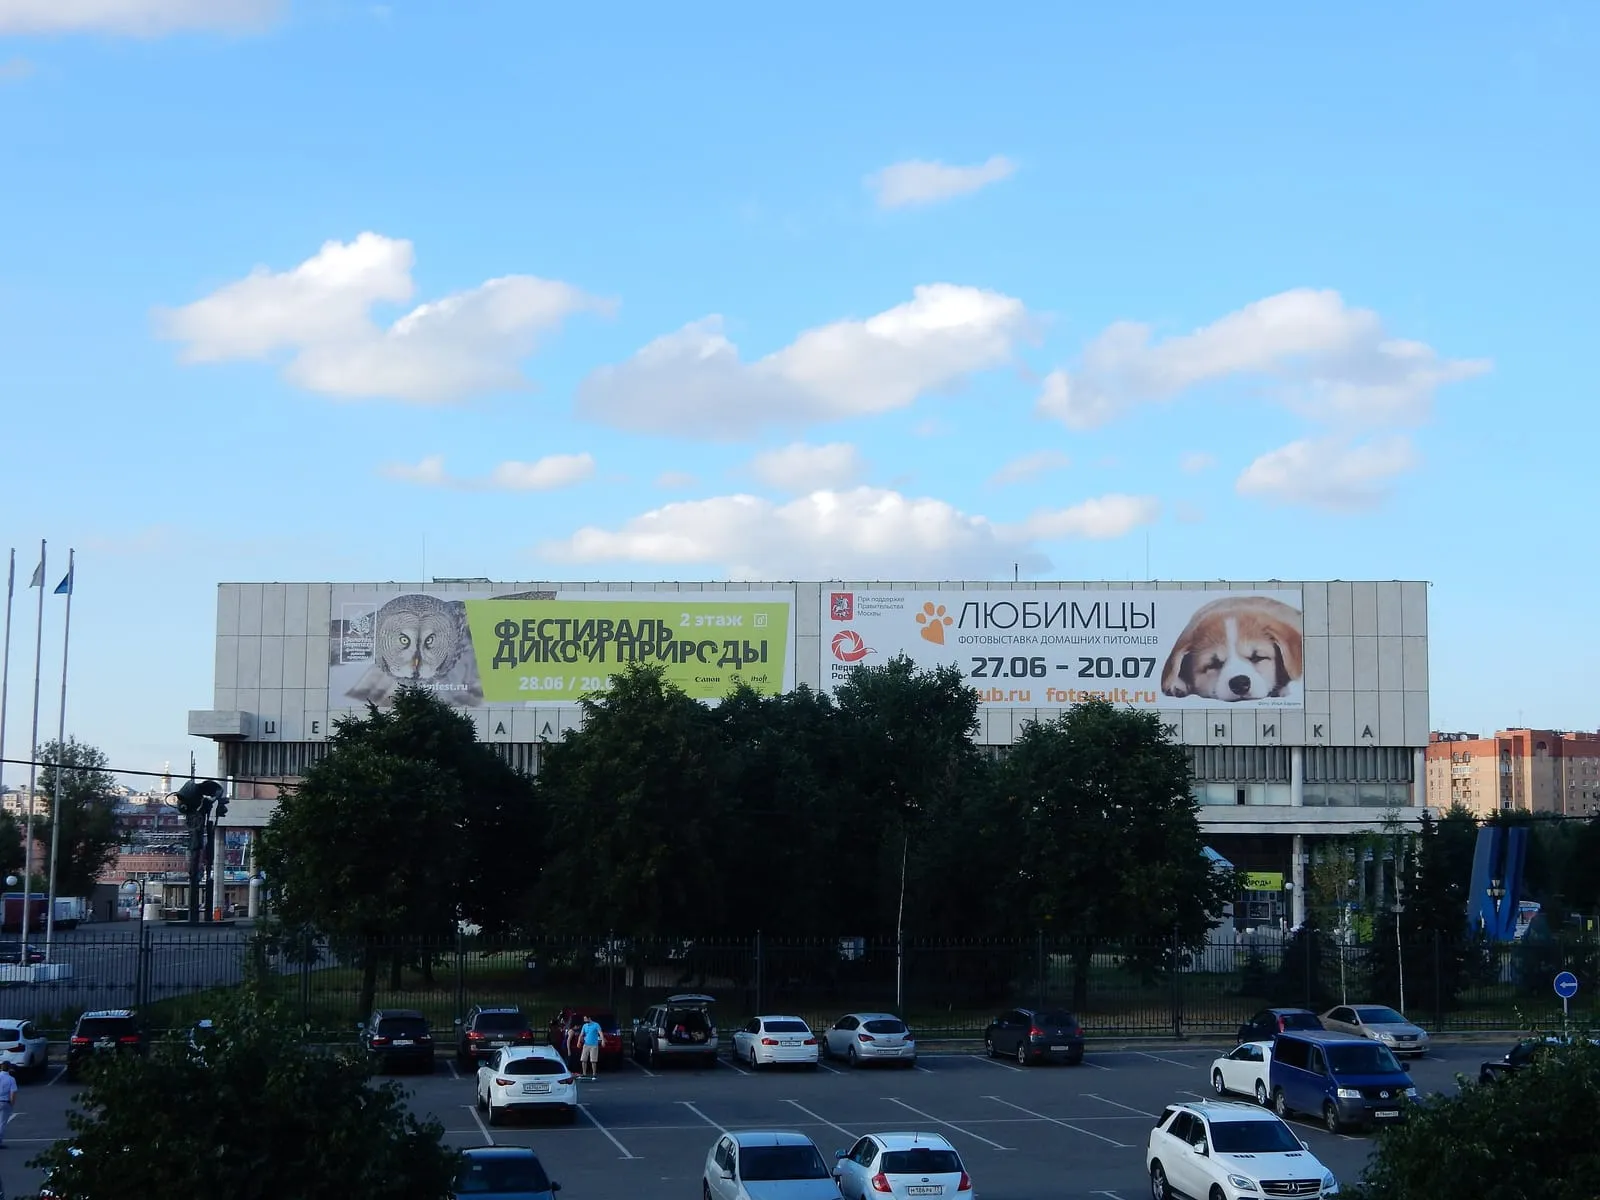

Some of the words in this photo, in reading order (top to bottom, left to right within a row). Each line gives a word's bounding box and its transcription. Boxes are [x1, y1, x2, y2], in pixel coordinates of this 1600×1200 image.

[679, 613, 690, 627] 2
[694, 615, 743, 627] этаж
[958, 601, 1156, 632] ЛЮБИМЦЫ
[494, 618, 673, 642] ФЕСТИВАЛЬ
[958, 634, 1038, 645] ФОТОВЫСТАВКА
[1040, 634, 1100, 645] ДОМАШНИХ
[1103, 634, 1159, 646] ПИТОМЦЕВ
[616, 639, 768, 670] ПРИРОДЫ
[971, 656, 1048, 679] 27.06
[1077, 656, 1157, 679] 20.07
[518, 676, 564, 691] 28.06
[580, 676, 616, 691] 20.0
[694, 675, 720, 683] Canon
[978, 687, 1031, 702] ub.ru
